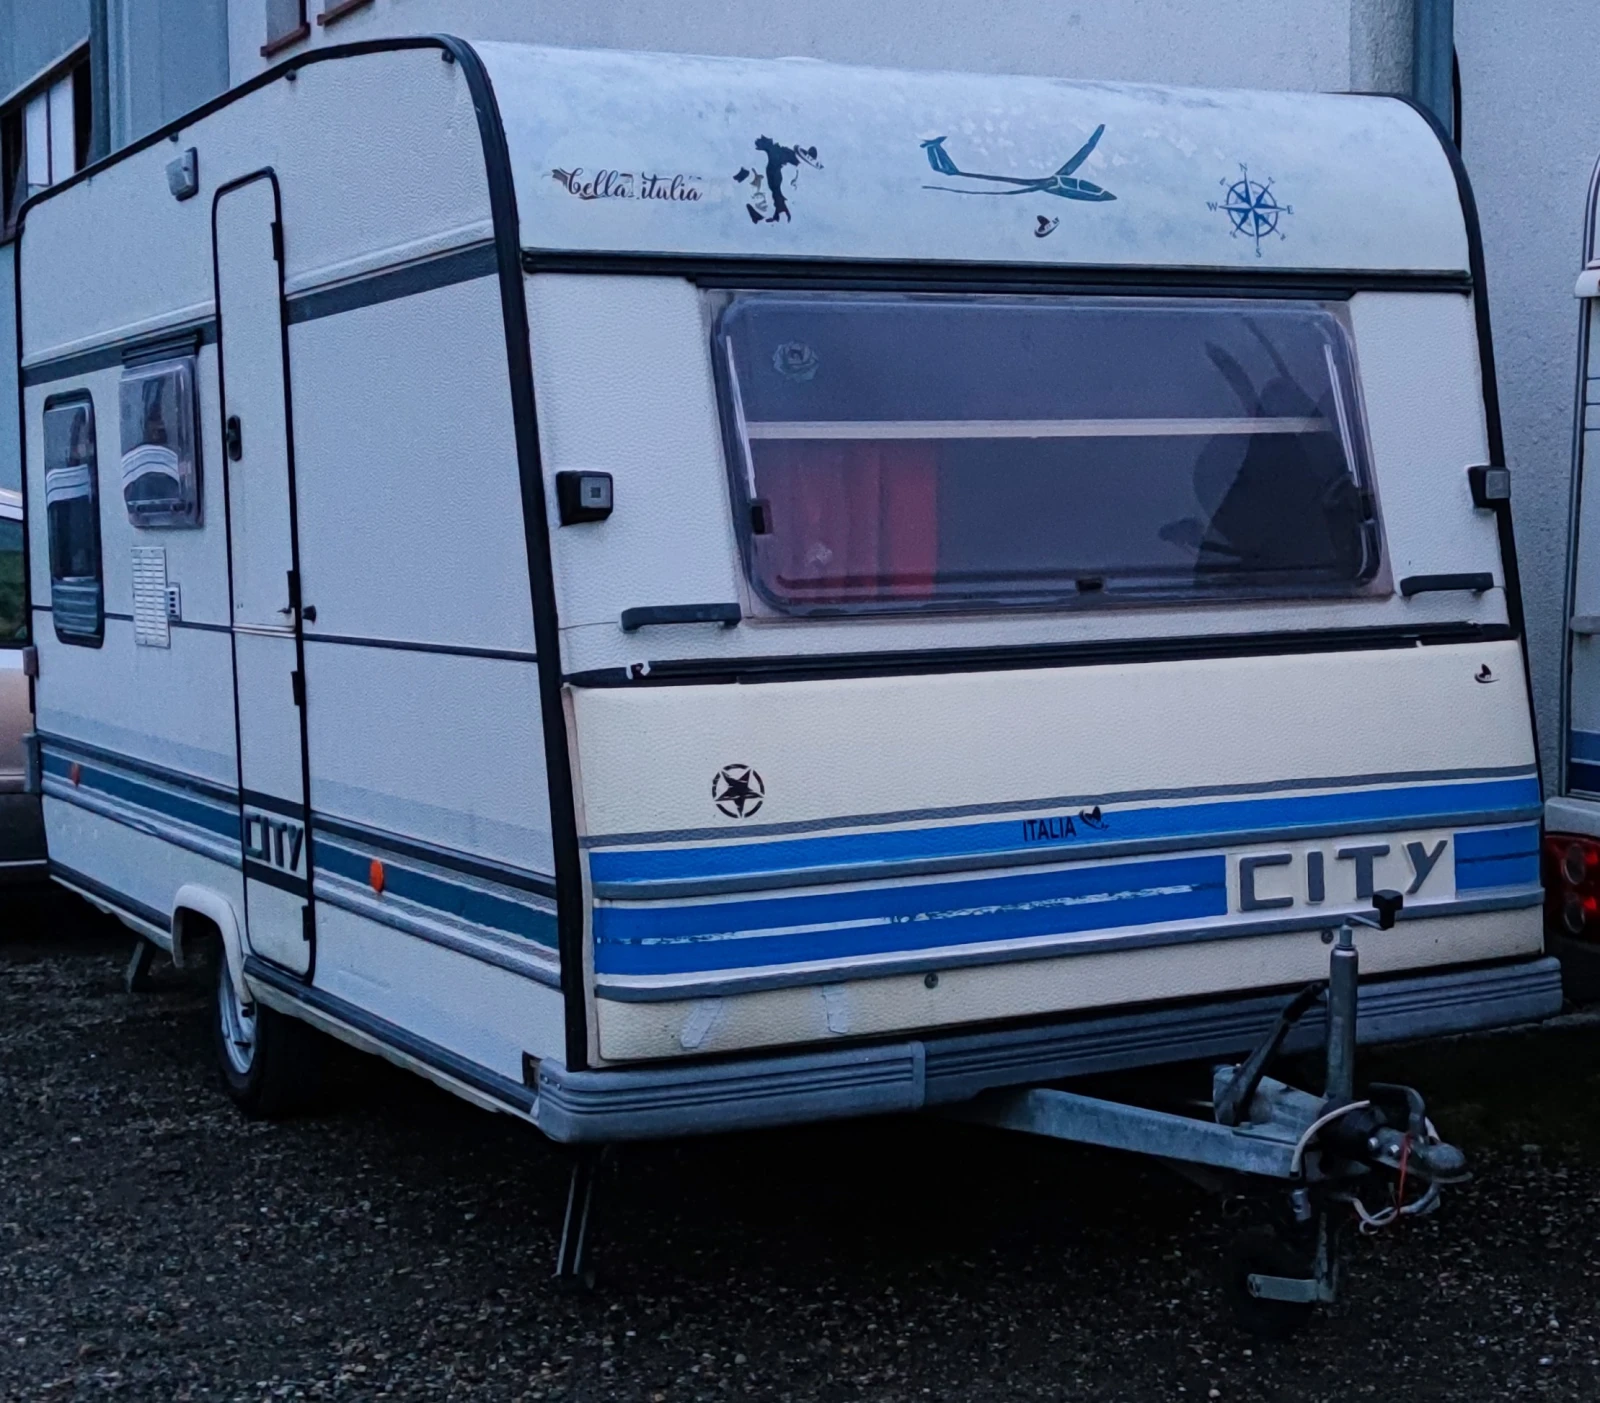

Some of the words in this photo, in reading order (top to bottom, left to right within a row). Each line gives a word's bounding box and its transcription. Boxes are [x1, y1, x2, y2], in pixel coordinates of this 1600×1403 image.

[245, 813, 304, 872] CITY
[1023, 816, 1077, 842] ITALIA
[1238, 839, 1448, 912] CITY
